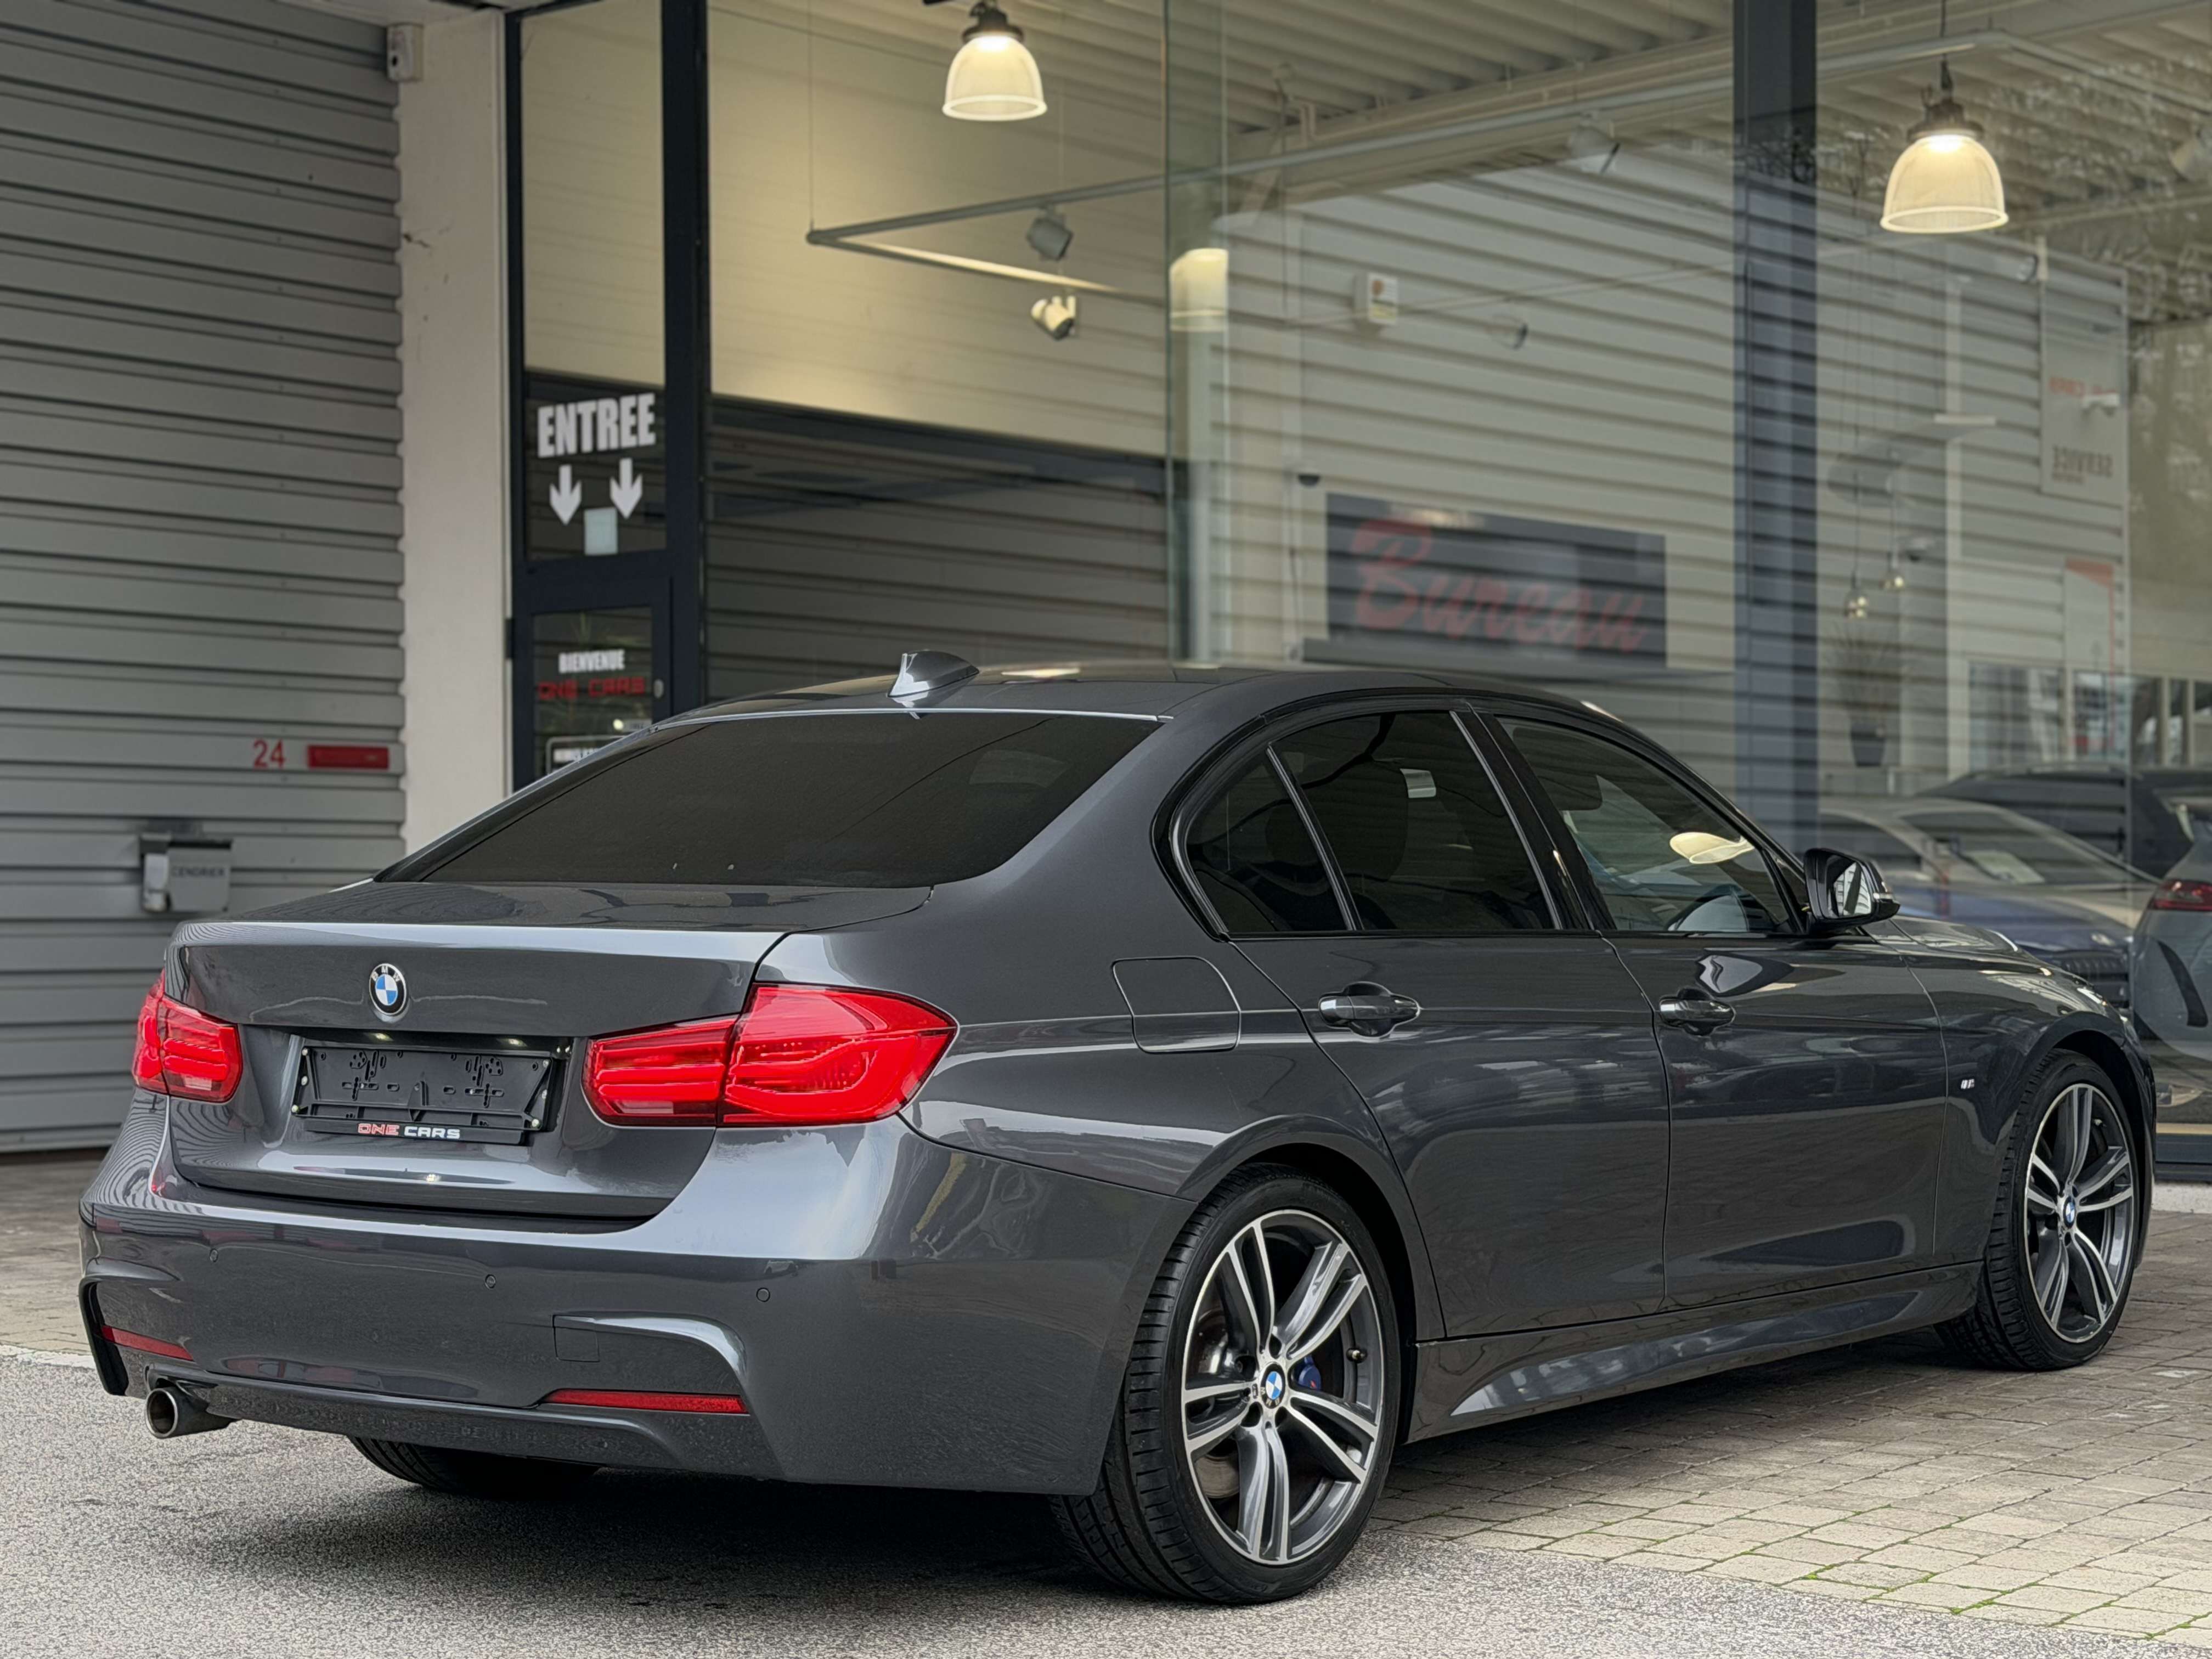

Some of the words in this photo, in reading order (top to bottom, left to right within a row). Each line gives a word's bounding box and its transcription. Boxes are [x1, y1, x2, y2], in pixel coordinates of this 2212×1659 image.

[538, 392, 656, 458] ENTREE
[1350, 518, 1645, 653] Bureau
[558, 650, 625, 673] BIENVENUE
[538, 680, 578, 700] ONE
[589, 676, 645, 696] CARS
[252, 739, 286, 768] 24
[371, 965, 401, 982] BMW
[358, 1123, 399, 1136] ONE
[404, 1126, 460, 1139] CARS
